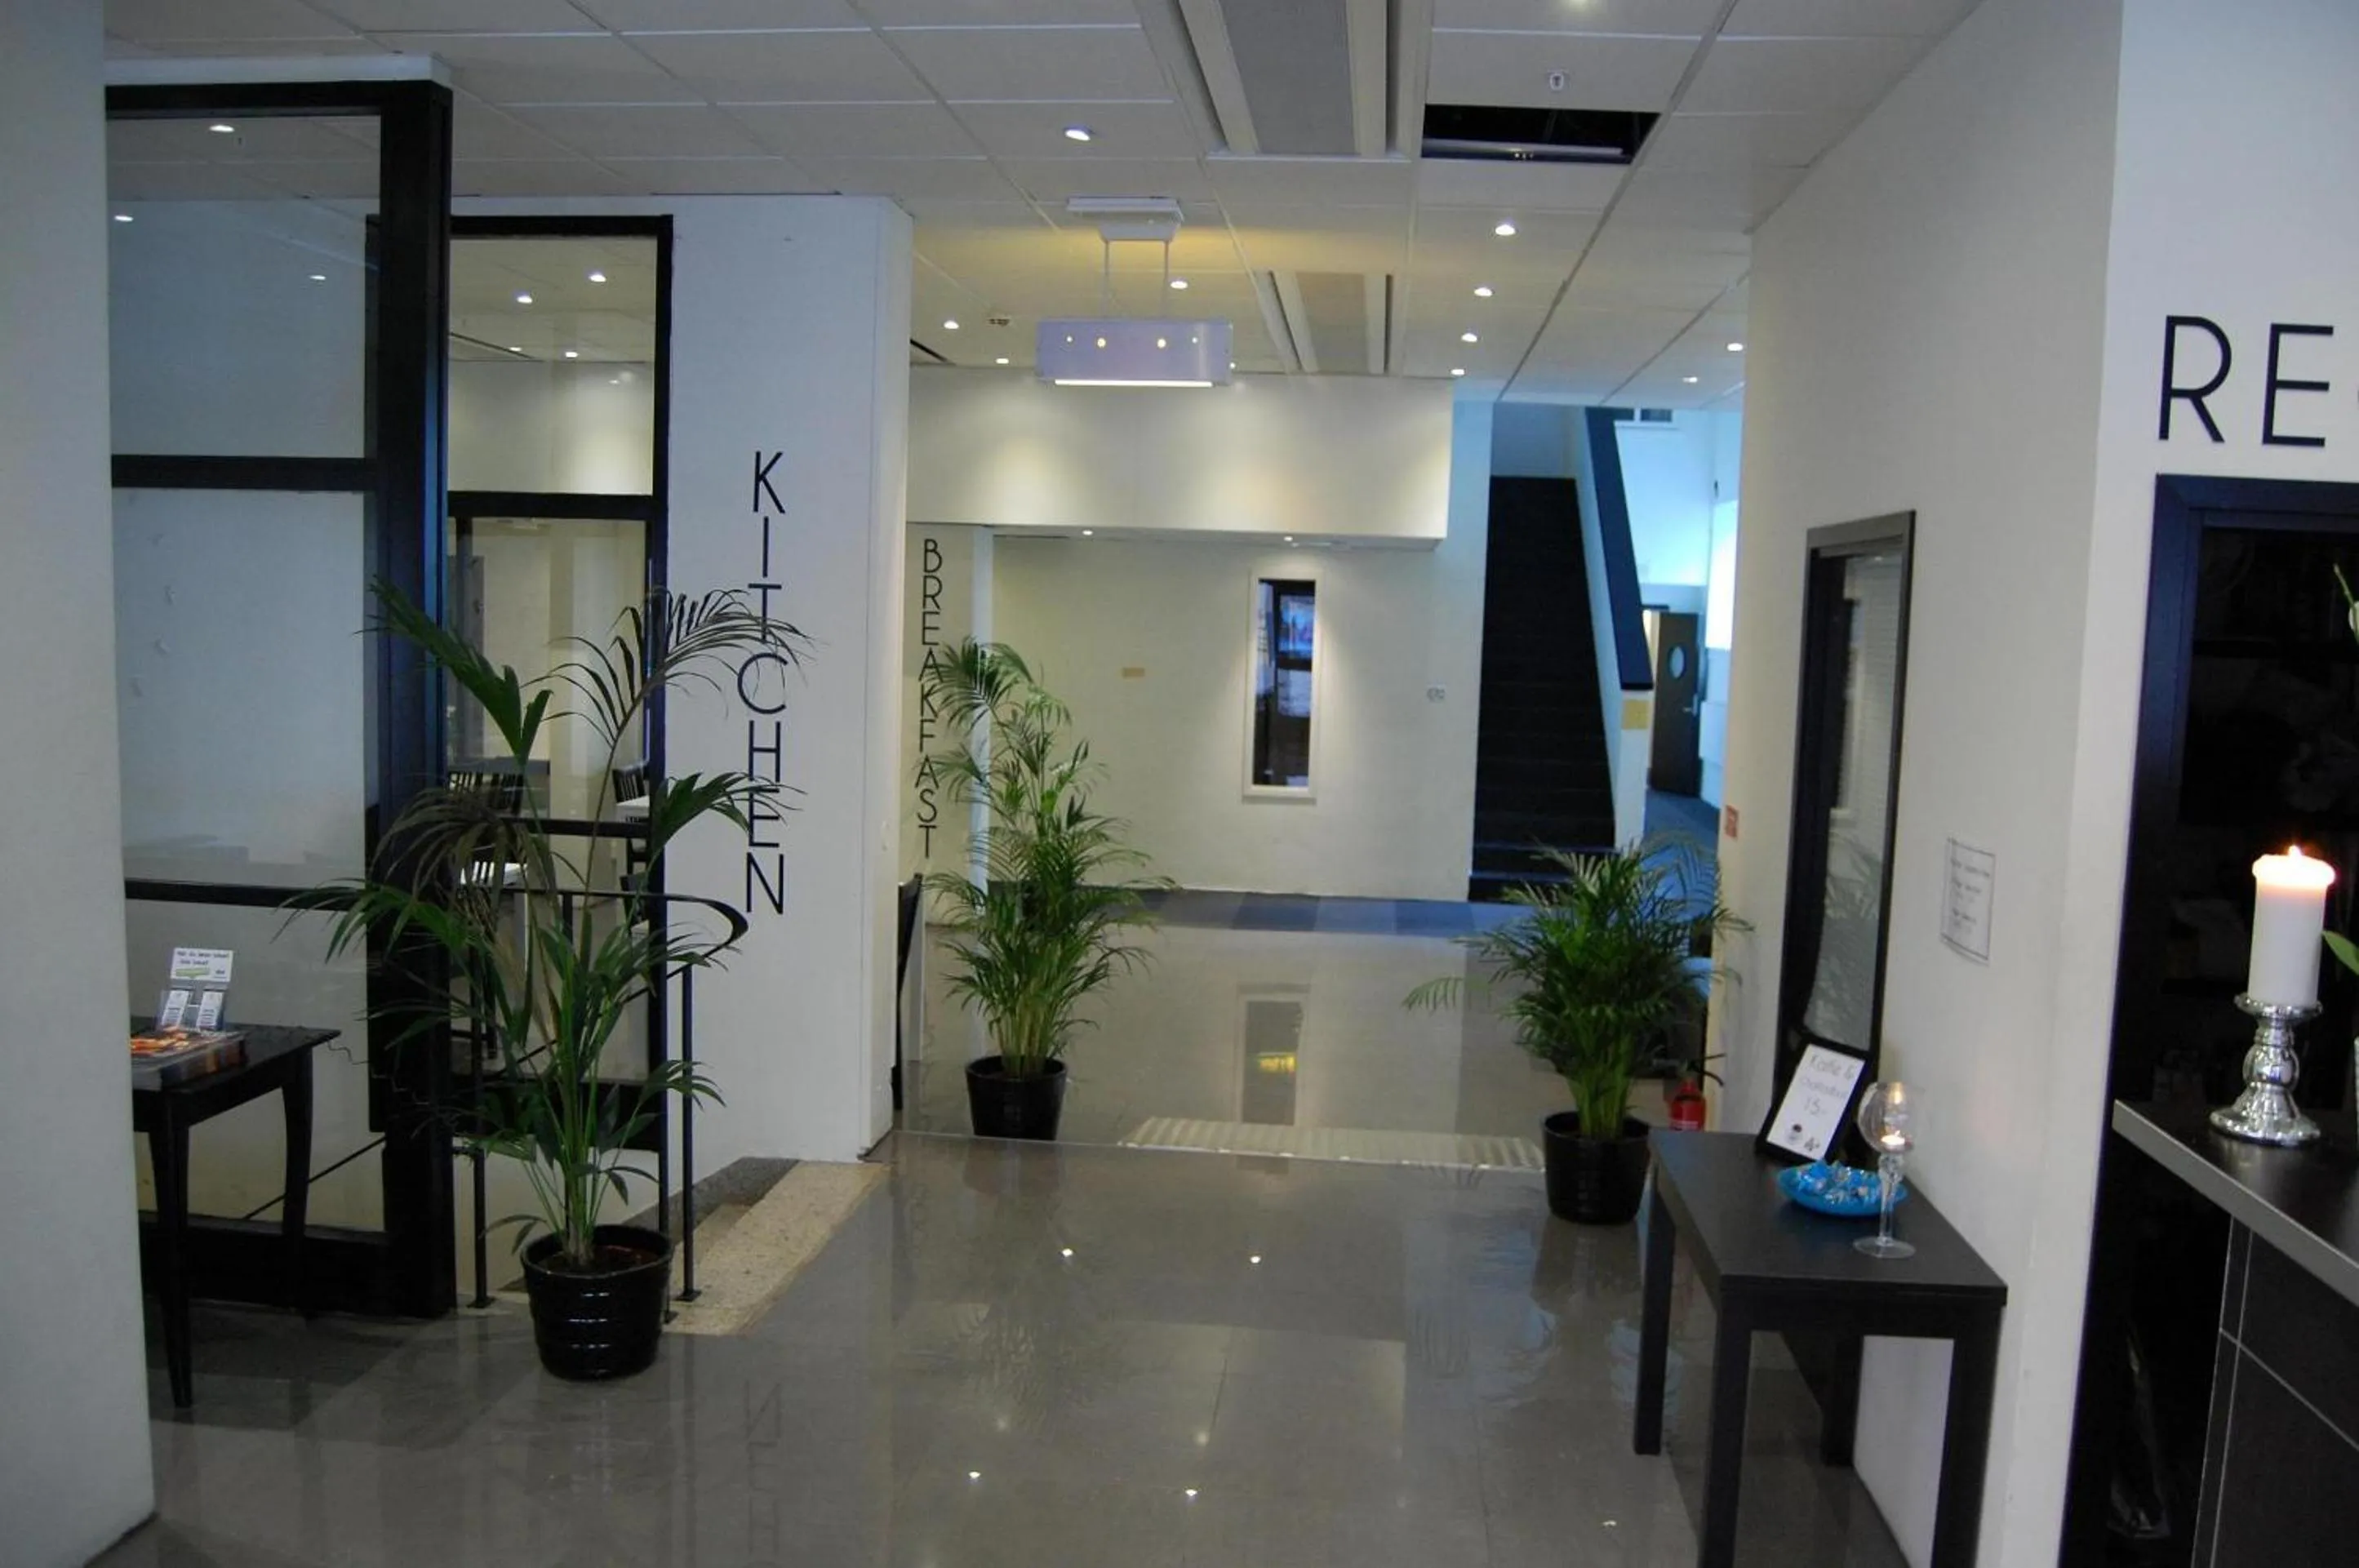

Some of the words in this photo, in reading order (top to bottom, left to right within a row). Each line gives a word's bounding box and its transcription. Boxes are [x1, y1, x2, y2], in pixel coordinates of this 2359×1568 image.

[2158, 314, 2359, 448] RE
[737, 450, 786, 915] KITCHEN
[914, 538, 943, 860] BREAKFAST
